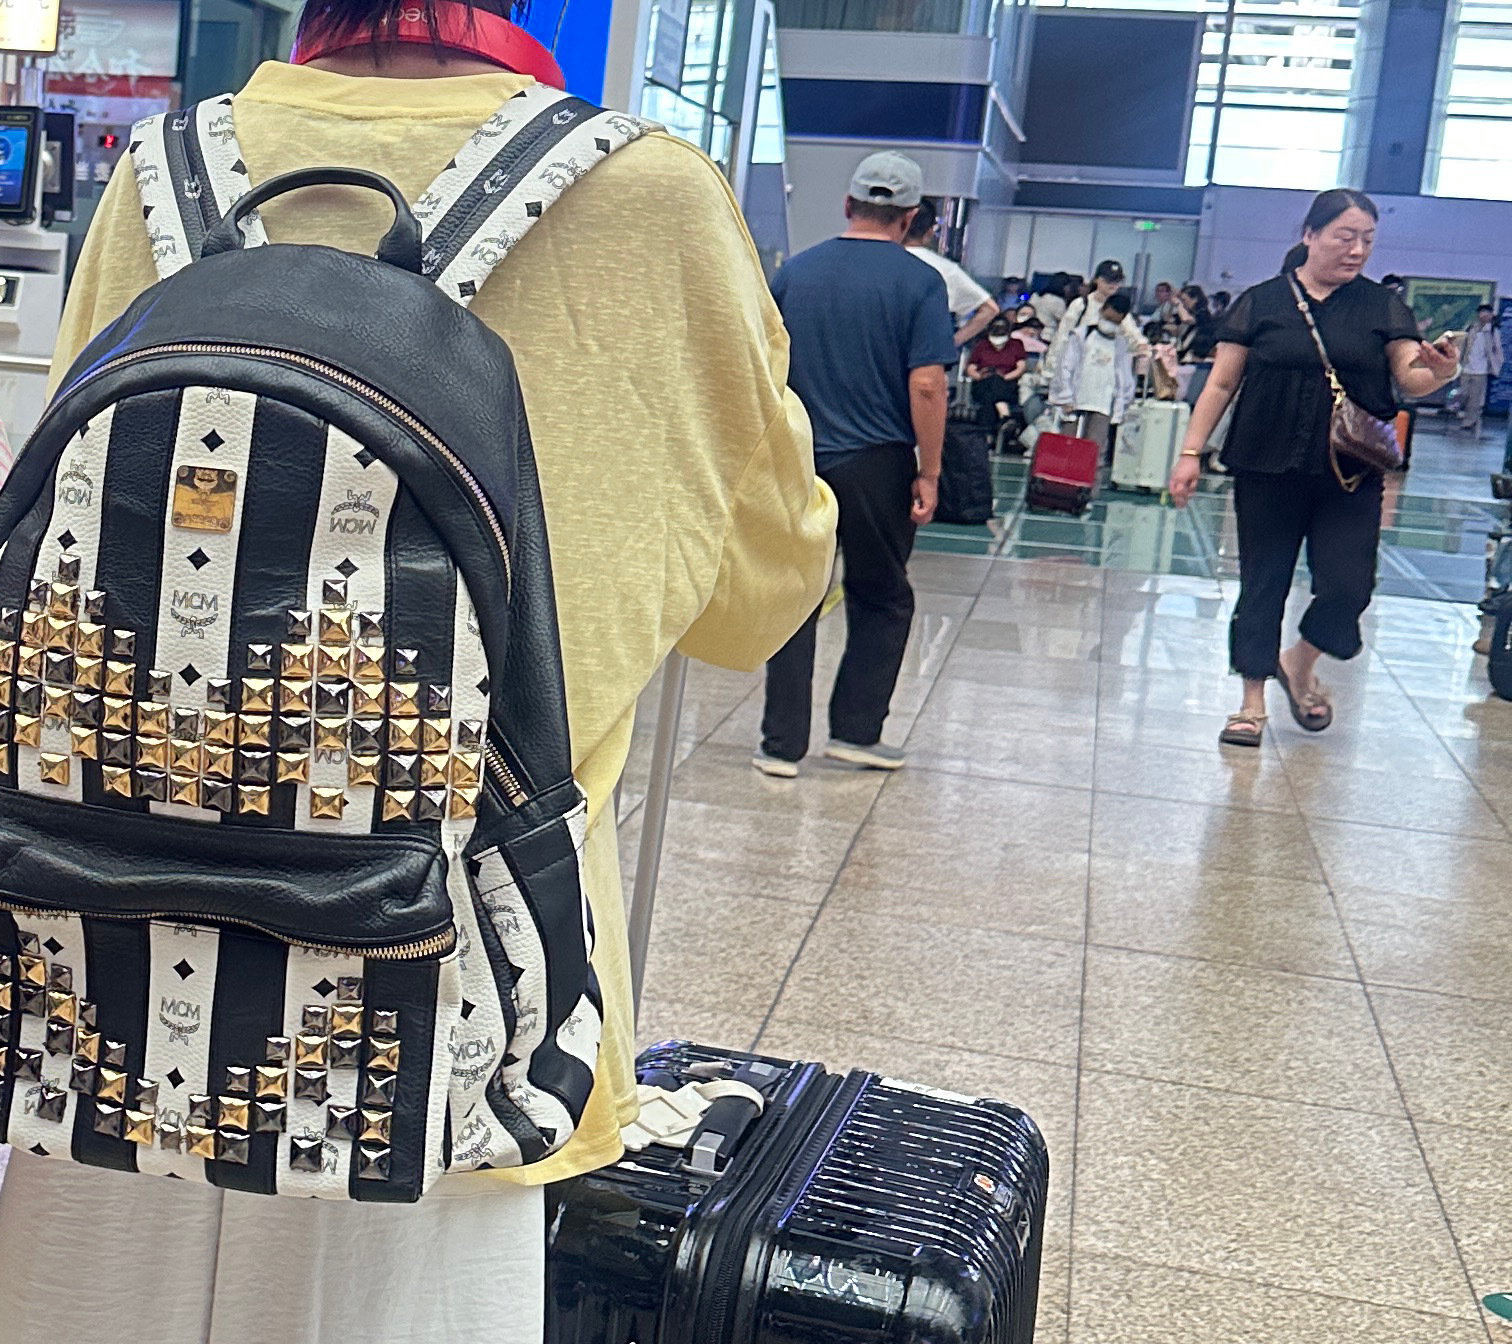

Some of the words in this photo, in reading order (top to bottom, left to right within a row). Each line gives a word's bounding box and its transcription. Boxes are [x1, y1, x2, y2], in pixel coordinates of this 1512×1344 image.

[58, 485, 93, 507] MCM
[329, 517, 378, 535] MCM
[171, 590, 219, 611] MCM
[159, 996, 202, 1019] MCM
[448, 1036, 496, 1061] MCM
